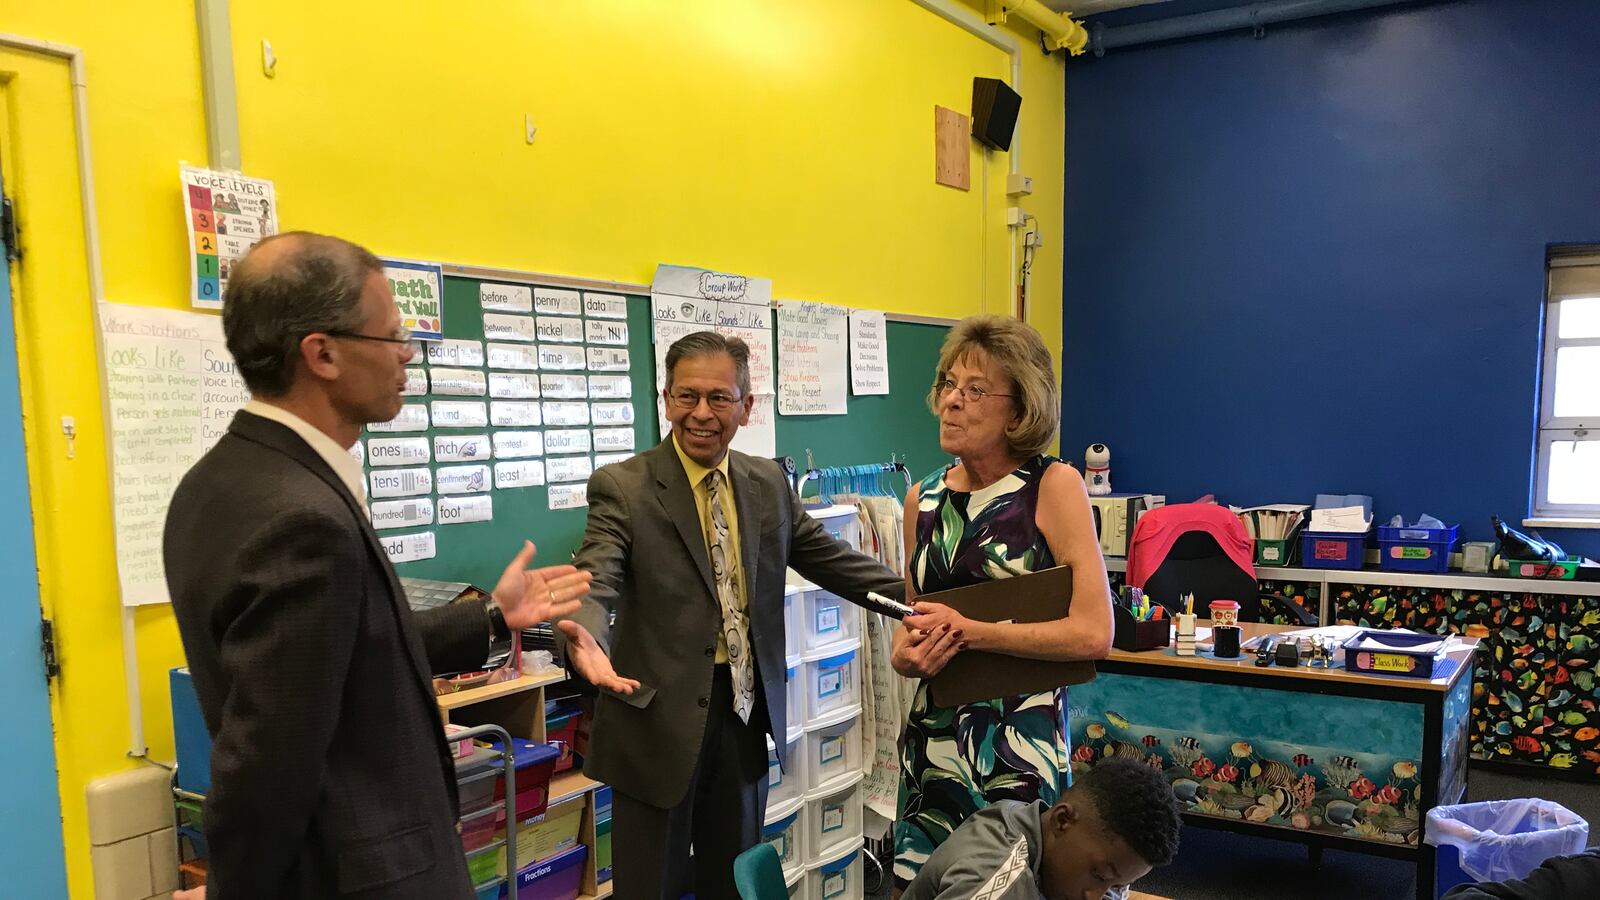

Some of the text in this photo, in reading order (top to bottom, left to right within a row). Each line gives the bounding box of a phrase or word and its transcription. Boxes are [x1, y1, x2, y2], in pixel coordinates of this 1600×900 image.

[194, 175, 264, 196] VOICE LEVELS
[198, 213, 209, 228] 3
[202, 237, 213, 250] 2
[204, 258, 210, 273] 1
[202, 282, 213, 296] 0
[705, 274, 743, 294] Group Work
[481, 289, 508, 304] before
[536, 296, 561, 309] penny
[395, 300, 438, 317] rd Wall
[586, 299, 606, 312] data
[104, 317, 200, 339] Work Stations
[485, 323, 513, 334] between
[537, 323, 563, 337] nickel
[591, 321, 604, 331] tally
[589, 334, 607, 342] marks
[428, 344, 459, 361] equal
[593, 348, 603, 356] bar
[204, 349, 239, 375] Soun
[591, 359, 607, 368] graph
[231, 376, 249, 388] lev
[541, 382, 563, 391] quarter
[866, 380, 881, 389] Respect
[203, 390, 250, 403] accounta
[784, 383, 822, 399] Show Respect
[785, 398, 802, 411] Follow
[804, 400, 828, 412] Directions
[433, 410, 460, 420] rund
[596, 408, 615, 420] hour
[203, 424, 224, 439] Com
[493, 439, 523, 450] greatest
[546, 435, 571, 448] dollar
[596, 435, 619, 445] minute
[371, 445, 401, 457] ones
[435, 441, 457, 455] inch
[374, 475, 400, 489] tens
[437, 474, 471, 484] centimeter
[496, 469, 520, 482] least
[554, 471, 567, 480] sign
[553, 498, 568, 508] point
[372, 509, 404, 520] hundred
[440, 504, 461, 518] foot
[1374, 656, 1408, 667] Class Work
[525, 866, 551, 882] Fractions
